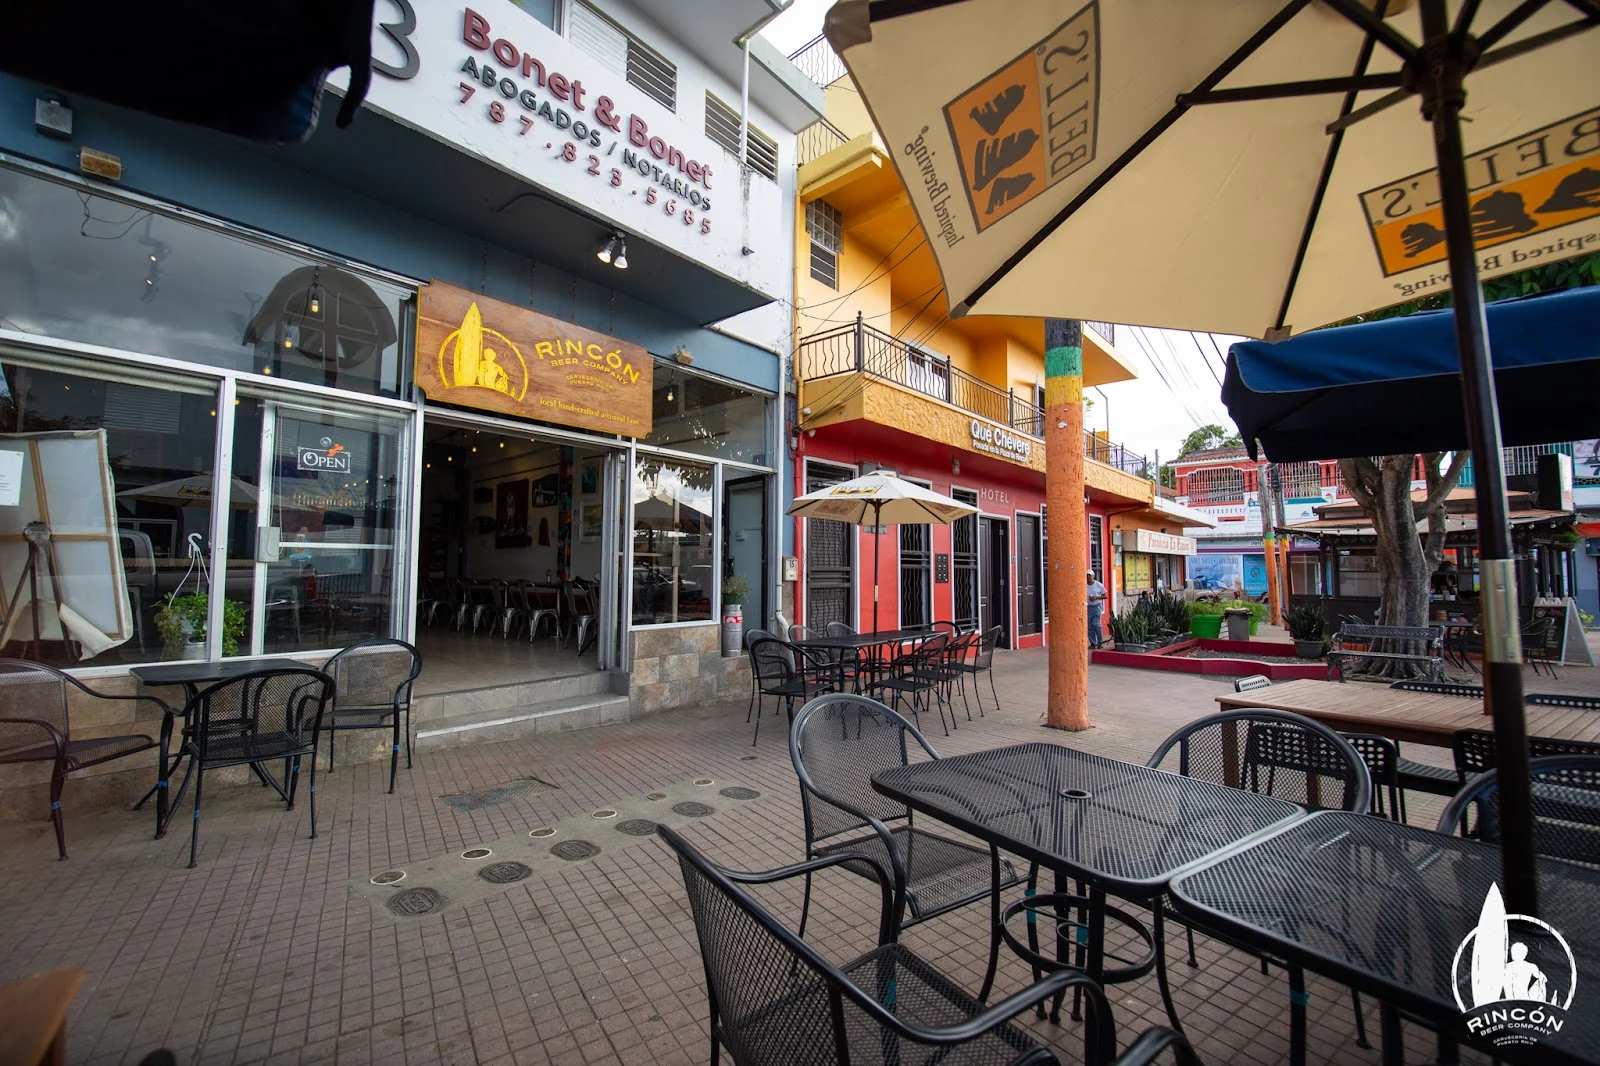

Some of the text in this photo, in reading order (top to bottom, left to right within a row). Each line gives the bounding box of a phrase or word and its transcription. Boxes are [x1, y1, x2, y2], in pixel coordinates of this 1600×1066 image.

[464, 7, 713, 190] Bonet & Bonet
[461, 55, 711, 211] ABOGADOS / NOTARIOS
[535, 339, 640, 384] RINCÓN
[551, 357, 629, 385] BEER COMPANY
[540, 396, 556, 408] local
[558, 400, 600, 416] hand-crafted
[601, 411, 627, 423] artisanal
[972, 419, 1030, 456] Qué Chévere
[303, 452, 345, 468] OPEN
[981, 488, 1009, 503] HOTEL
